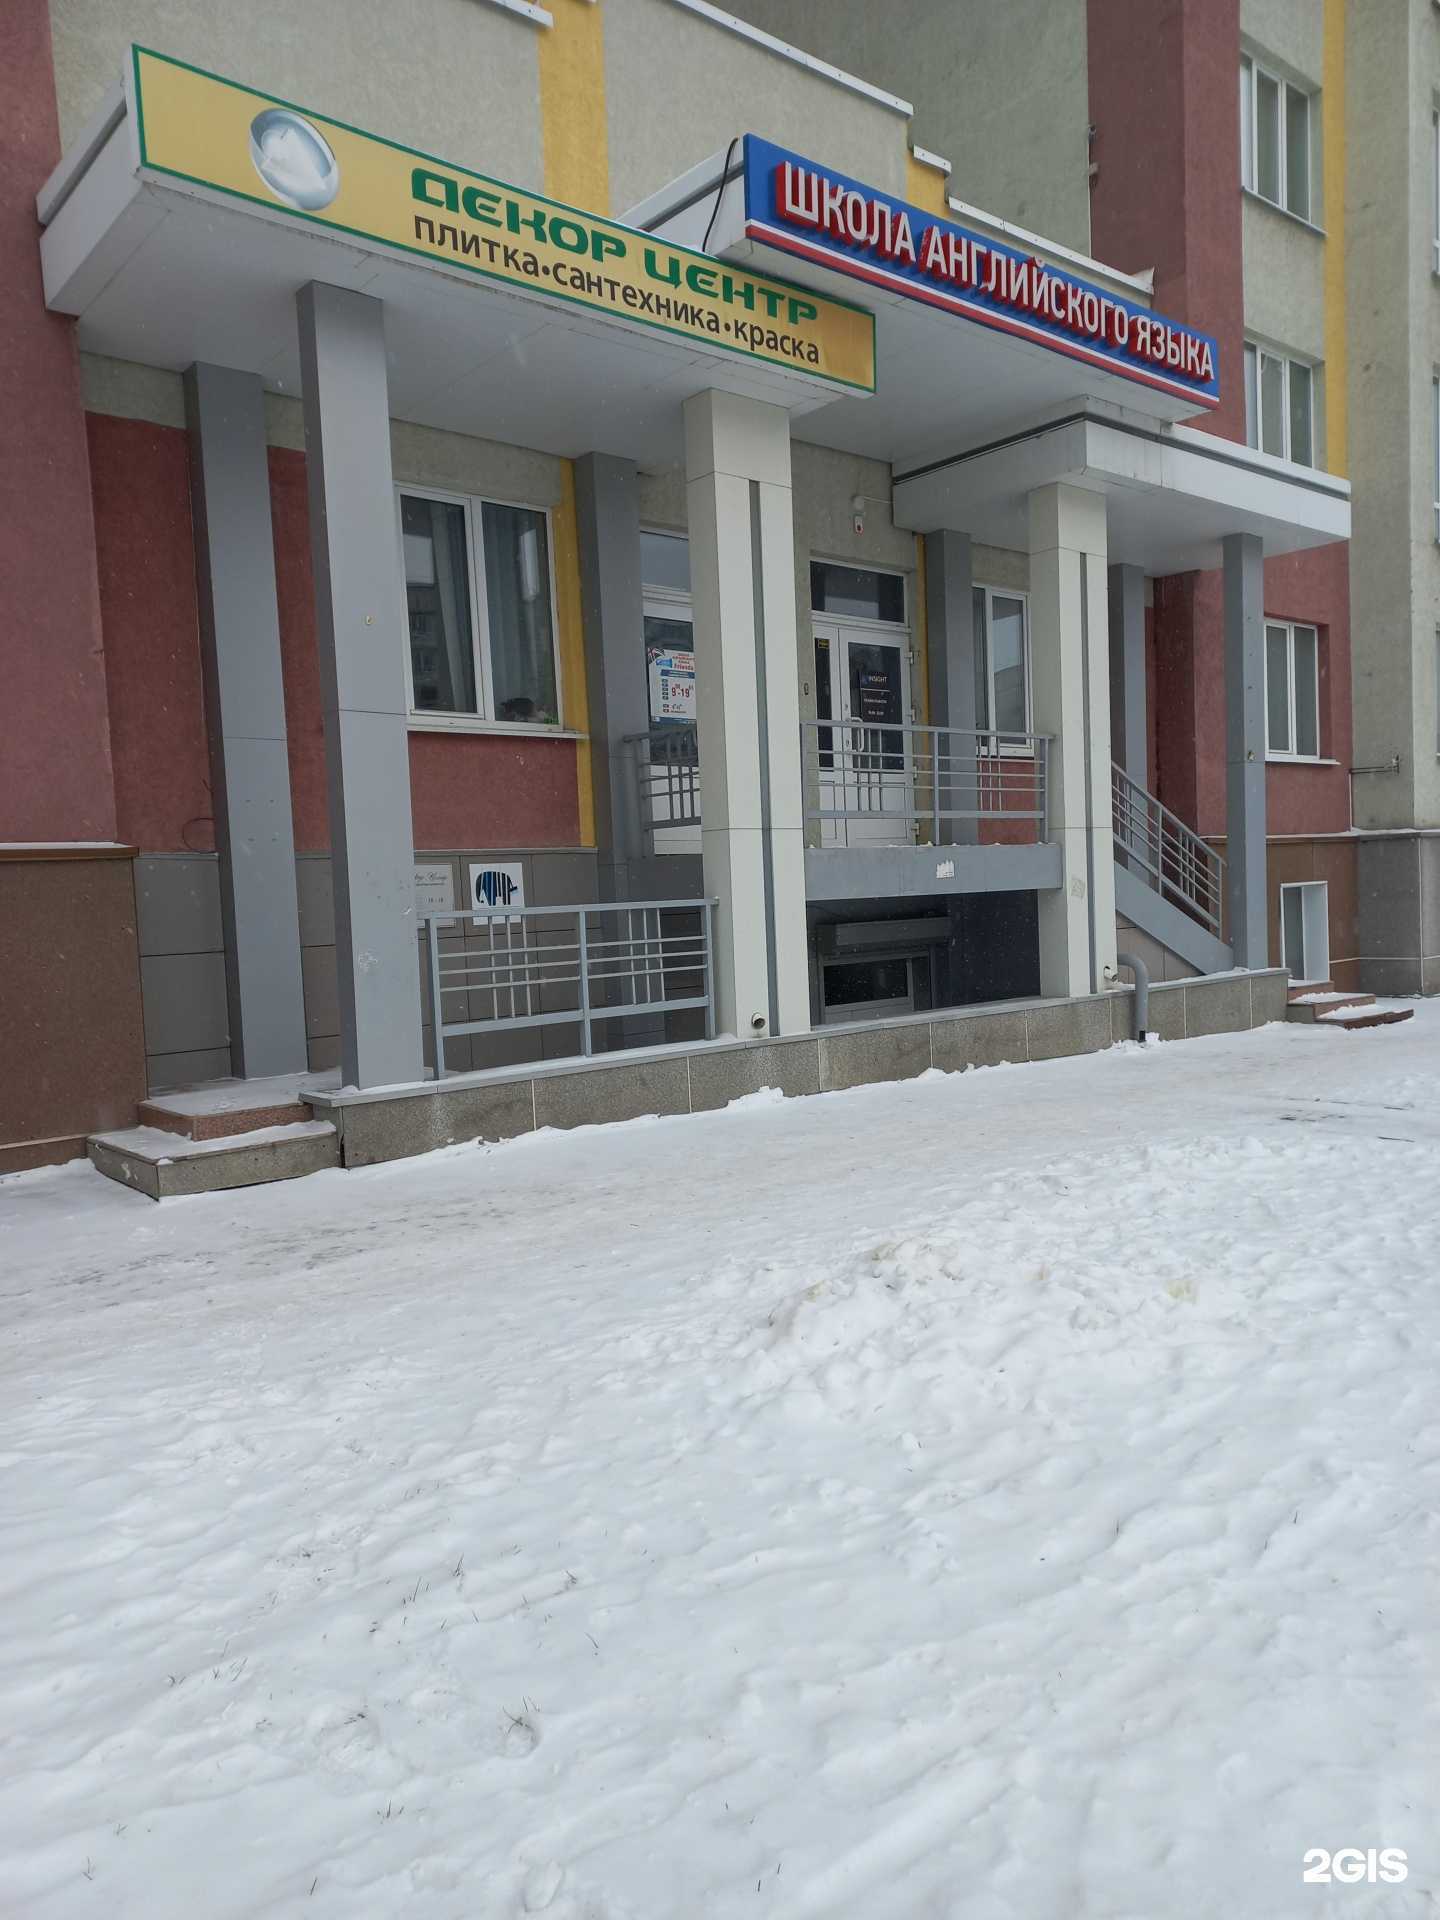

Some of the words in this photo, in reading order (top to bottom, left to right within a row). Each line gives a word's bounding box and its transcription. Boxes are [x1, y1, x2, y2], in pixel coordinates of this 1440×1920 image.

[411, 167, 627, 263] ДЕКОР
[644, 247, 817, 325] ЦЕНТР
[414, 215, 539, 277] плитка
[552, 262, 720, 334] сантехника
[734, 318, 819, 364] краска
[780, 160, 917, 263] ШКОЛА
[922, 224, 1129, 345] АНГЛИЙСКОГО
[1132, 314, 1215, 380] ЯЗЫКА
